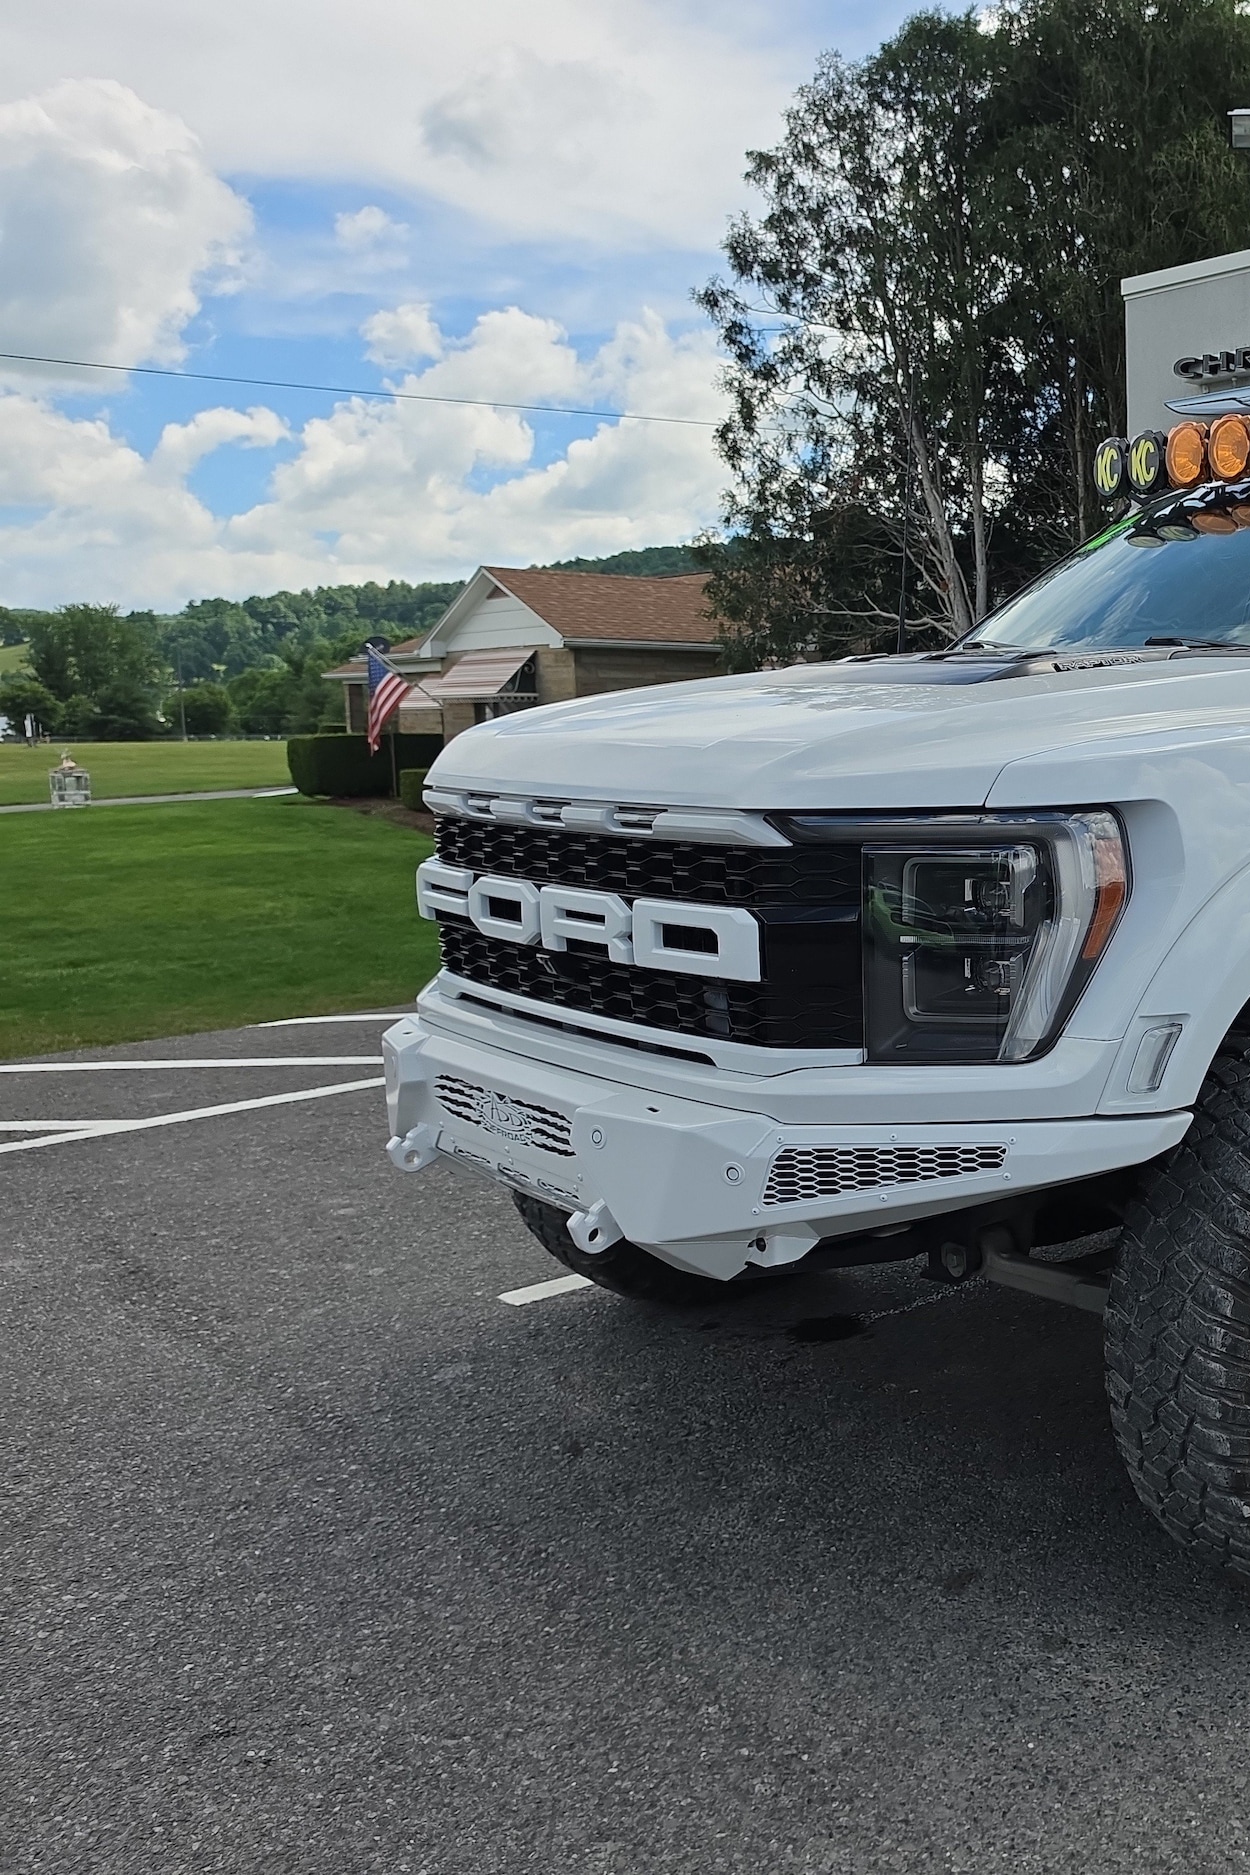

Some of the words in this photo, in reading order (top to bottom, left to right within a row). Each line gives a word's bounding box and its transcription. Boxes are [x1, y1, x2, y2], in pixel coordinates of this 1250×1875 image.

[1097, 446, 1118, 492] KC
[1131, 439, 1154, 486] KC
[1058, 654, 1143, 672] RAPTOR
[416, 858, 761, 982] FORD
